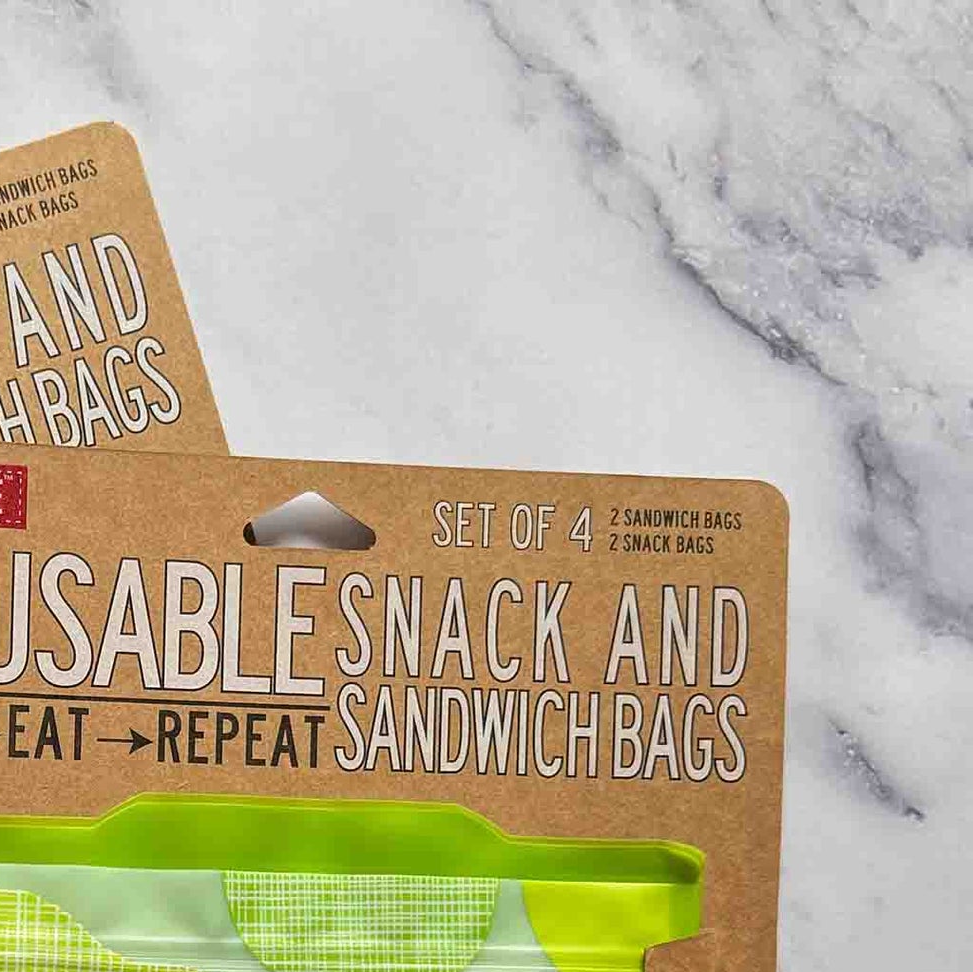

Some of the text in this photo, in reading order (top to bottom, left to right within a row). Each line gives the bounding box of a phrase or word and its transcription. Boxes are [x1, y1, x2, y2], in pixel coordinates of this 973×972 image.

[57, 159, 99, 185] BAGS
[39, 191, 79, 218] BAGS
[2, 233, 149, 368] AND
[33, 336, 182, 448] BAGS
[431, 500, 593, 553] SET OF 4
[608, 533, 715, 554] 2 SNACK BAGS
[609, 508, 743, 531] 2 SANDWICH BAGS
[335, 571, 749, 688] SNACK AND
[7, 704, 90, 761] EAT
[156, 709, 326, 769] REPEAT
[334, 682, 748, 783] SANDWICH BAGS
